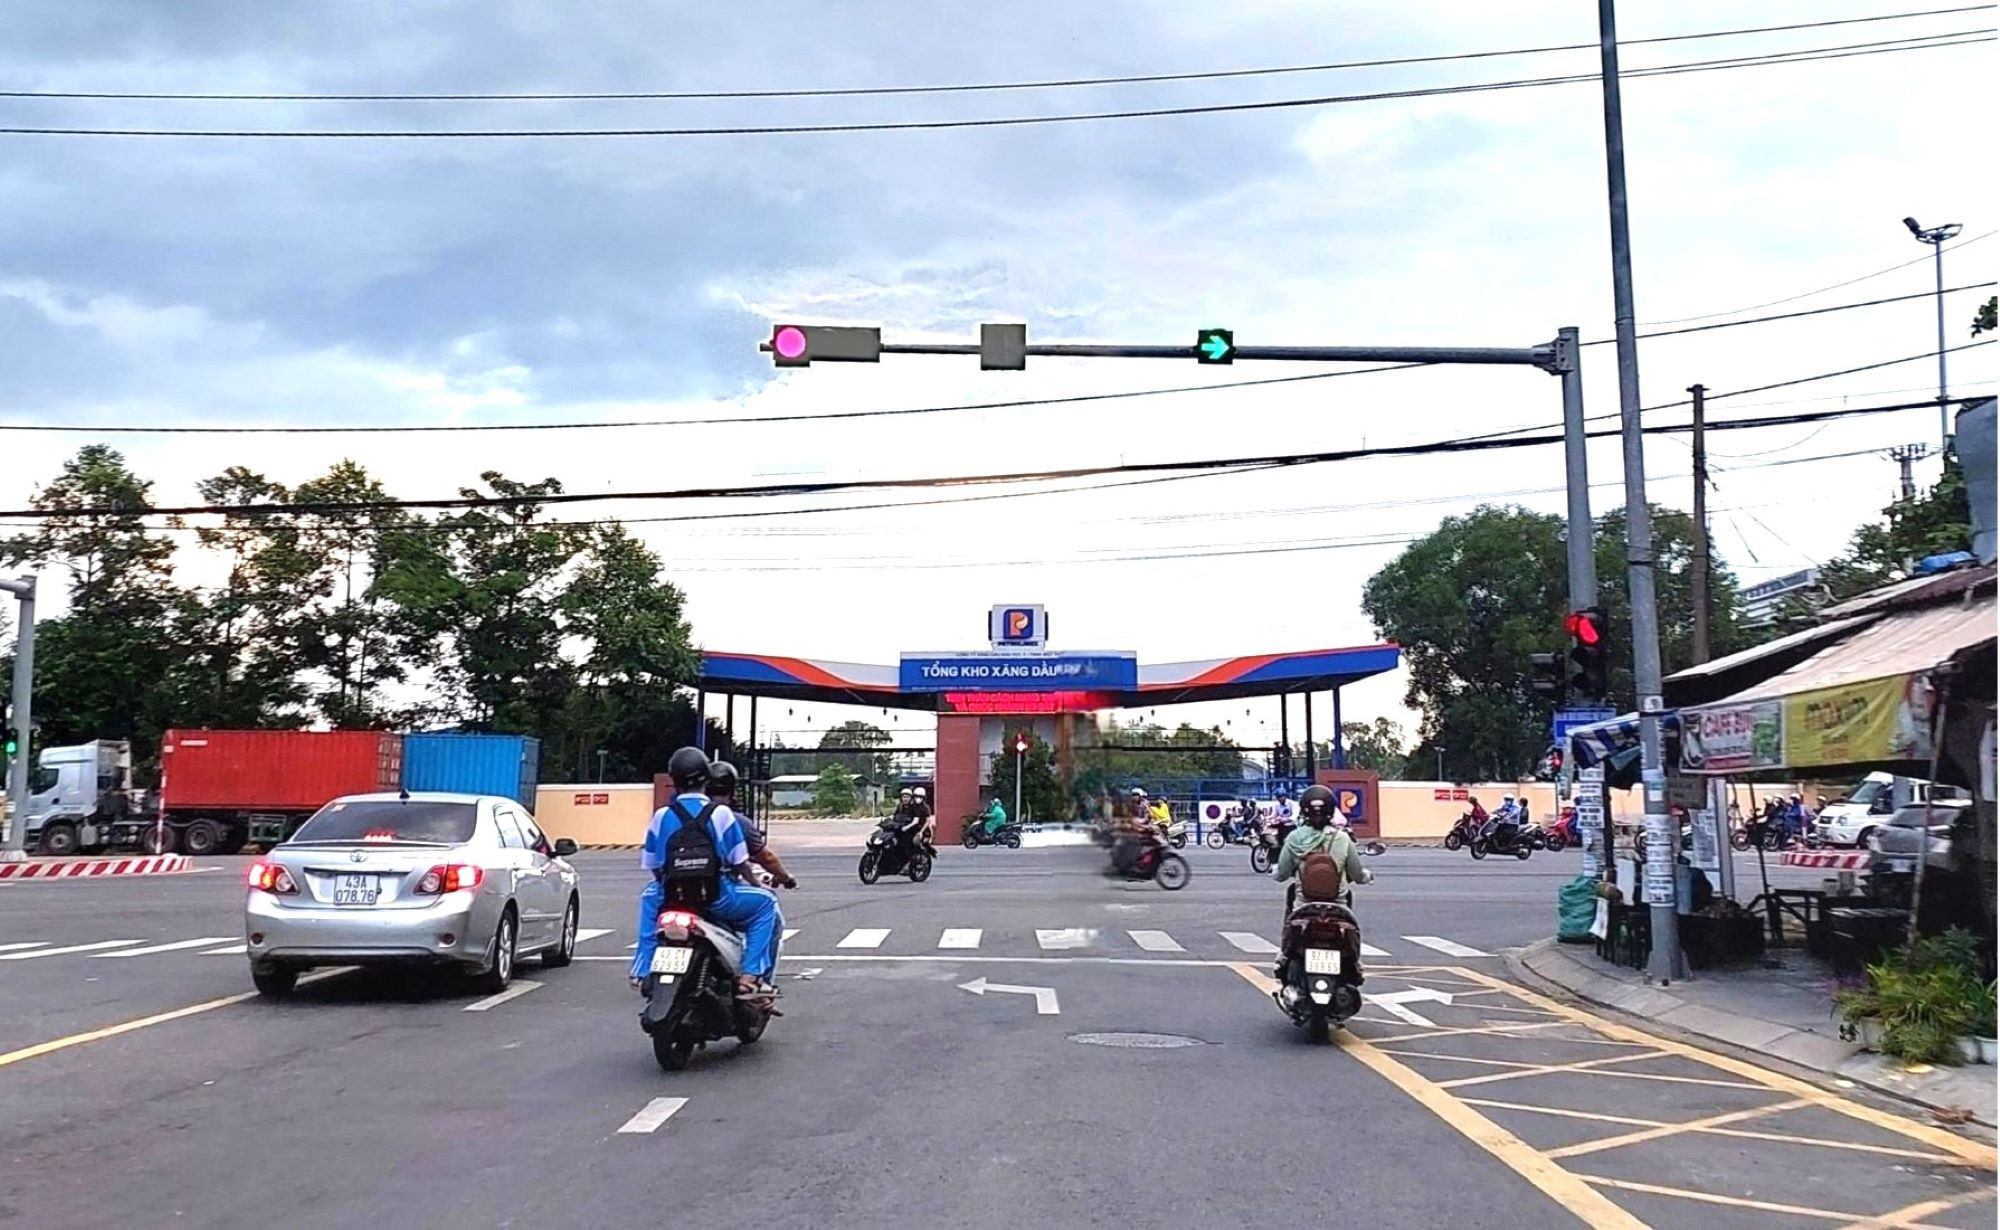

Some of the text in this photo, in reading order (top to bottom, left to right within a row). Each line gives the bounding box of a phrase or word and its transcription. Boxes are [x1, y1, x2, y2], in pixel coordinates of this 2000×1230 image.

[921, 661, 959, 677] TỔNG
[961, 666, 989, 677] KHO
[992, 664, 1029, 677] XĂNG
[1032, 660, 1057, 677] DẦU
[345, 875, 367, 888] 43A
[335, 889, 375, 903] 078.76
